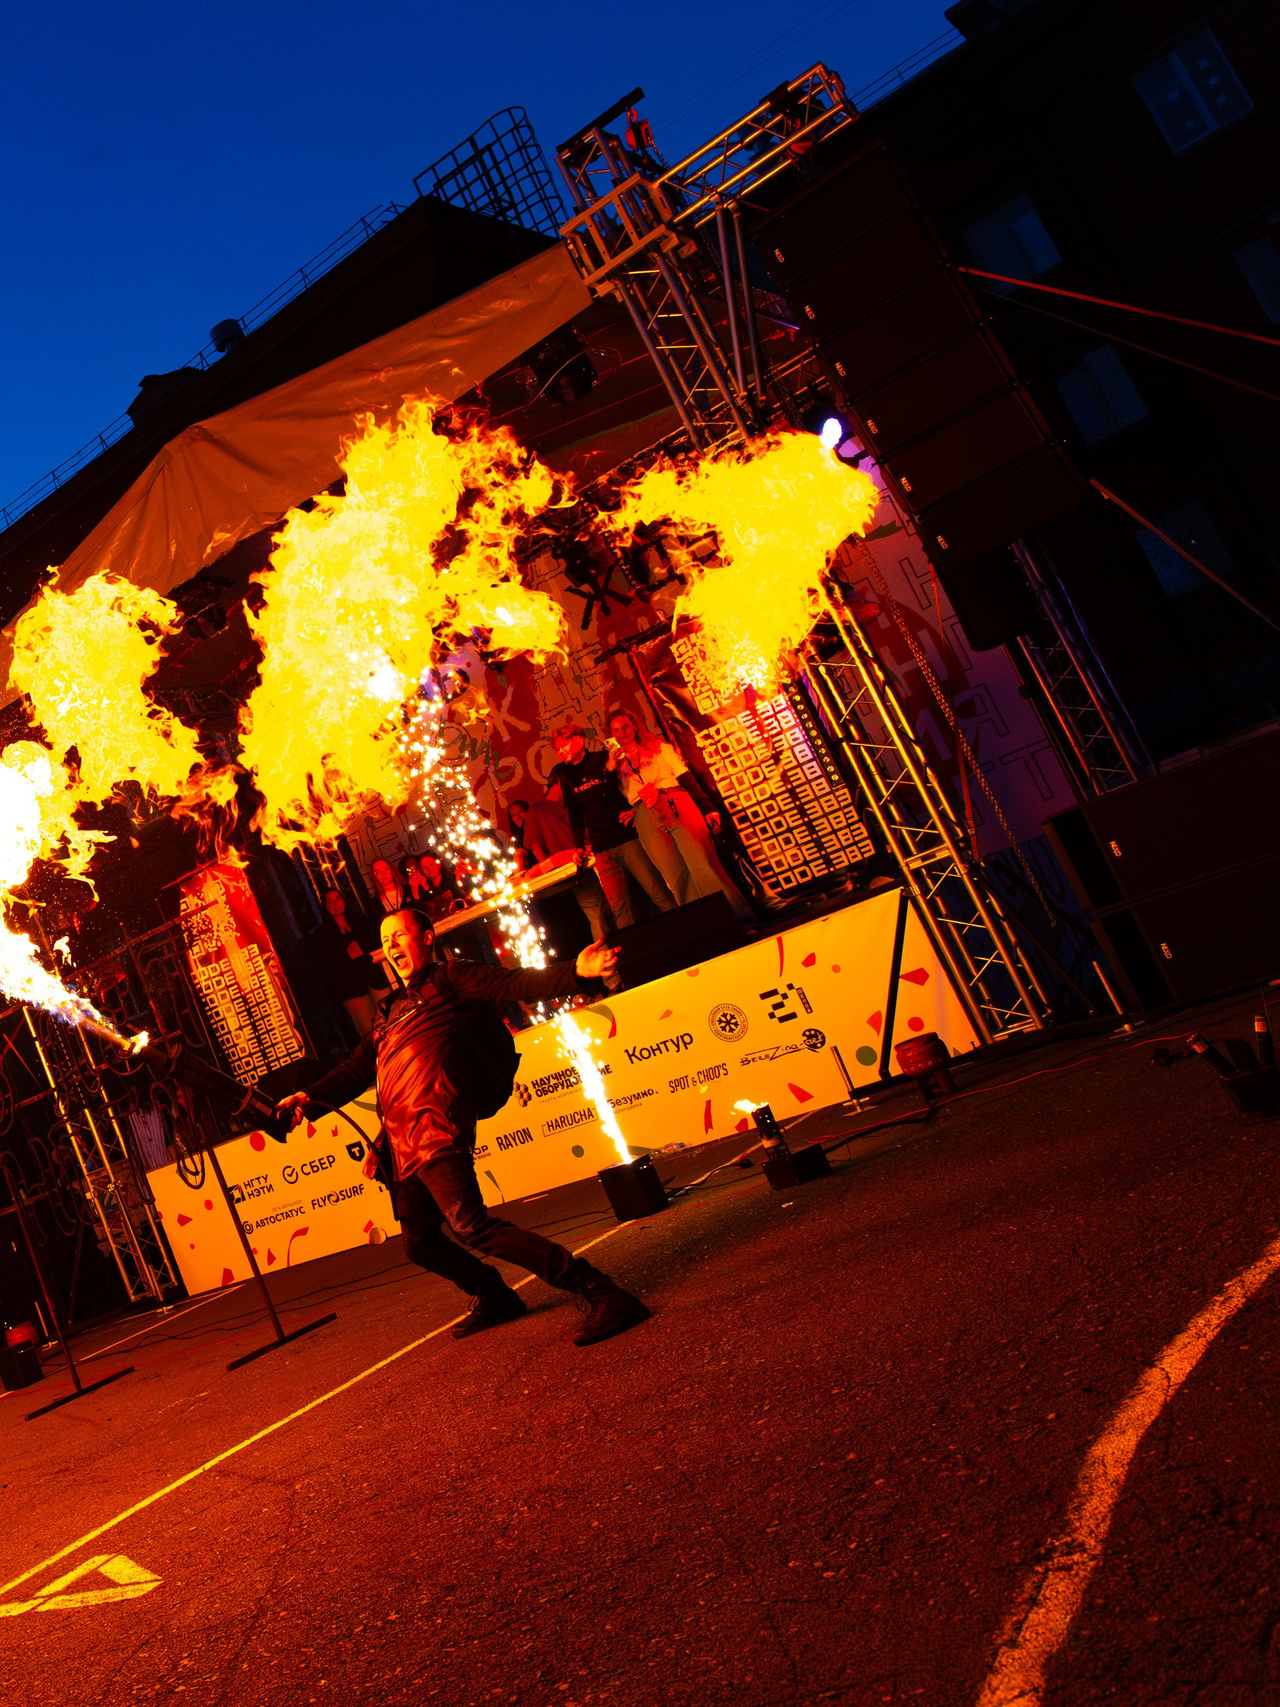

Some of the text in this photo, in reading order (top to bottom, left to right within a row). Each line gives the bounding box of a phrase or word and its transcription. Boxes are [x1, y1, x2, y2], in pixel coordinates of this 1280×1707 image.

[716, 742, 814, 797] CODE.38
[724, 760, 821, 813] CODE.38
[732, 776, 831, 830] CODE.38
[739, 787, 852, 846] CODE.383
[746, 805, 859, 862] CODE.383
[755, 821, 868, 878] CODE.383
[763, 839, 875, 895] CODE.383
[624, 1032, 694, 1064] Контур
[531, 1066, 579, 1090] НАУЧНОЕ
[669, 1075, 690, 1094] SPOT
[697, 1063, 729, 1084] CHOO'S
[546, 1107, 595, 1132] HARUCHA
[496, 1127, 534, 1152] RAYON
[301, 1154, 336, 1176] СБЕР
[243, 1174, 269, 1190] НГТУ
[247, 1183, 275, 1200] НЭТИ
[255, 1206, 306, 1229] АВТОСТАТУС
